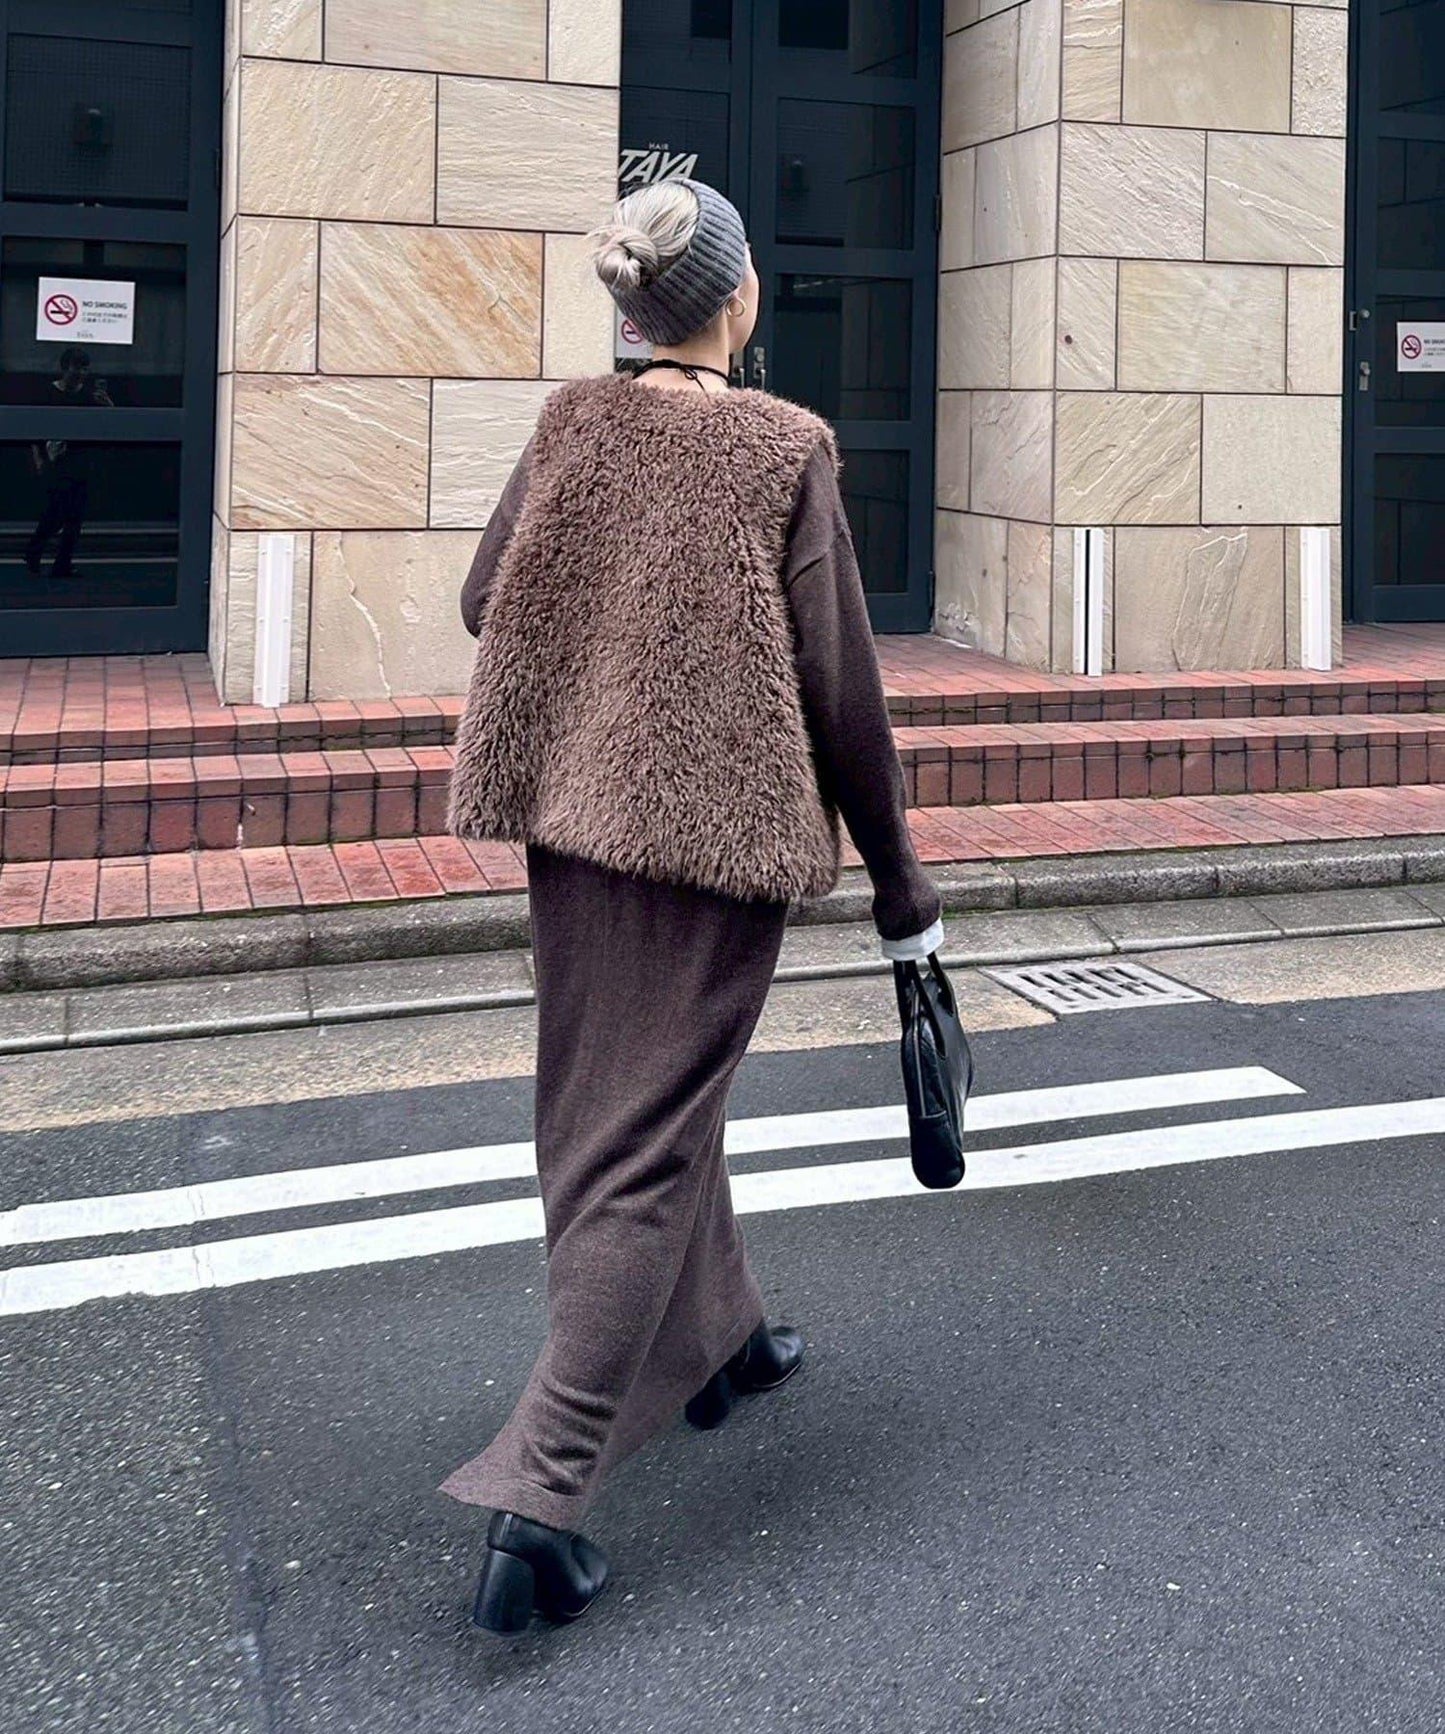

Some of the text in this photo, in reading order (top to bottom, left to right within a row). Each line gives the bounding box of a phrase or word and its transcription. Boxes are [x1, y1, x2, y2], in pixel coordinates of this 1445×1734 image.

[648, 142, 669, 150] HAIR
[618, 149, 698, 183] TAYA
[95, 301, 128, 309] SMOKING
